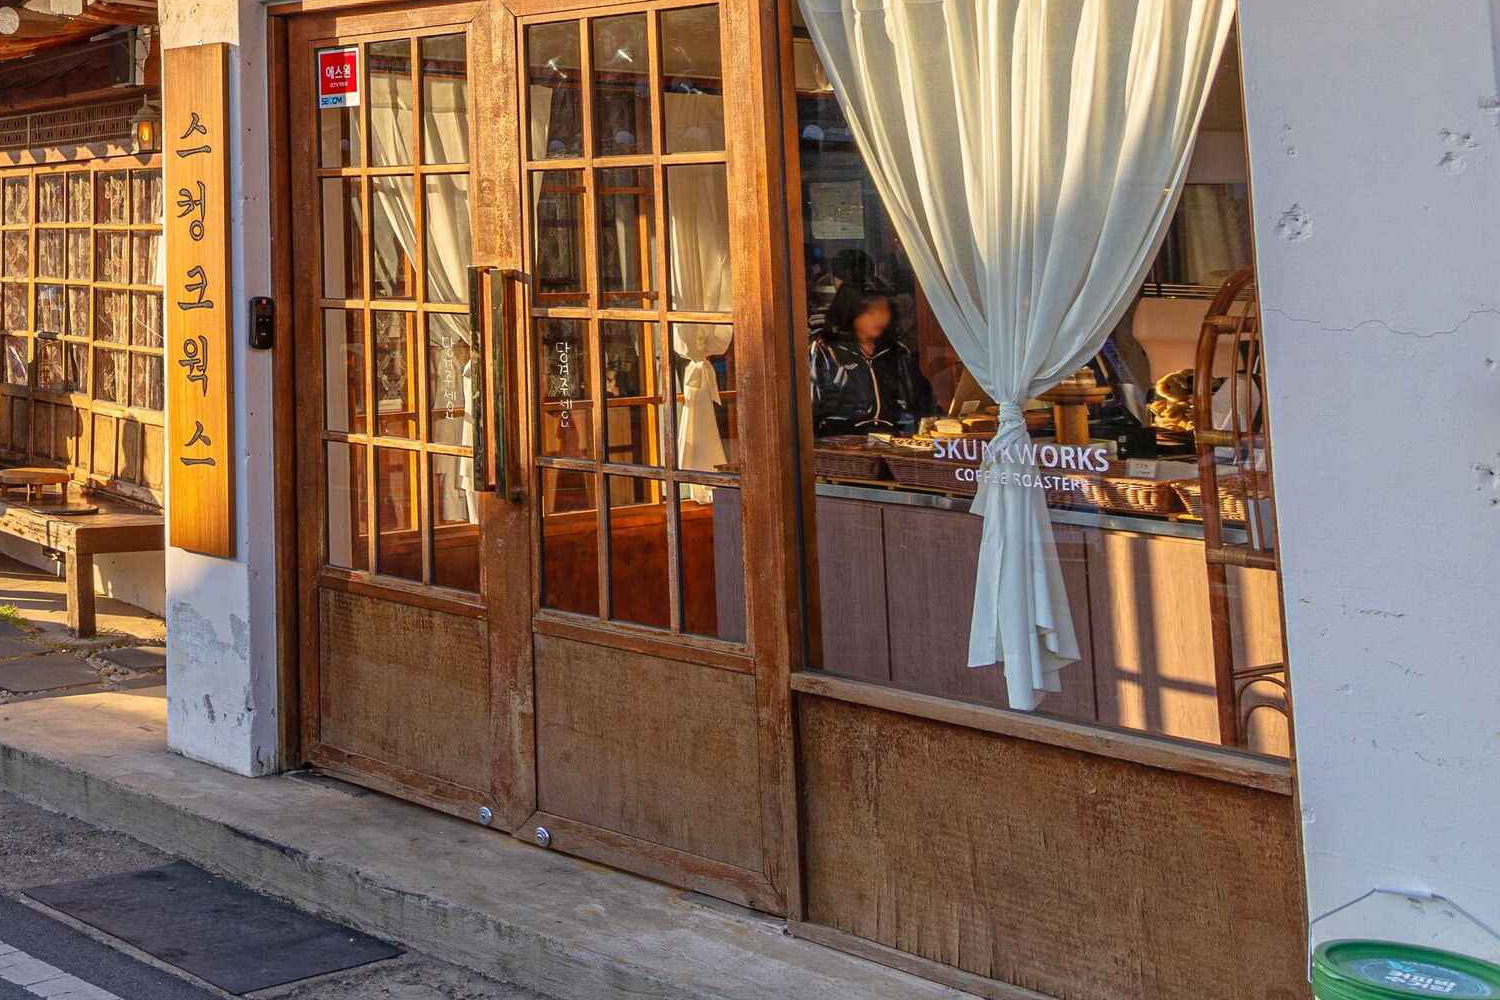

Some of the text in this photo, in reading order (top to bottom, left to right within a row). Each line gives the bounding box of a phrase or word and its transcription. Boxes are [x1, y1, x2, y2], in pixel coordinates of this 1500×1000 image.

[325, 64, 351, 79] 에스원
[176, 112, 216, 466] 스컹크웍스
[442, 336, 457, 422] 당겨주세요
[556, 342, 573, 428] 당겨주세요
[933, 438, 1109, 473] SKUNKWORKS
